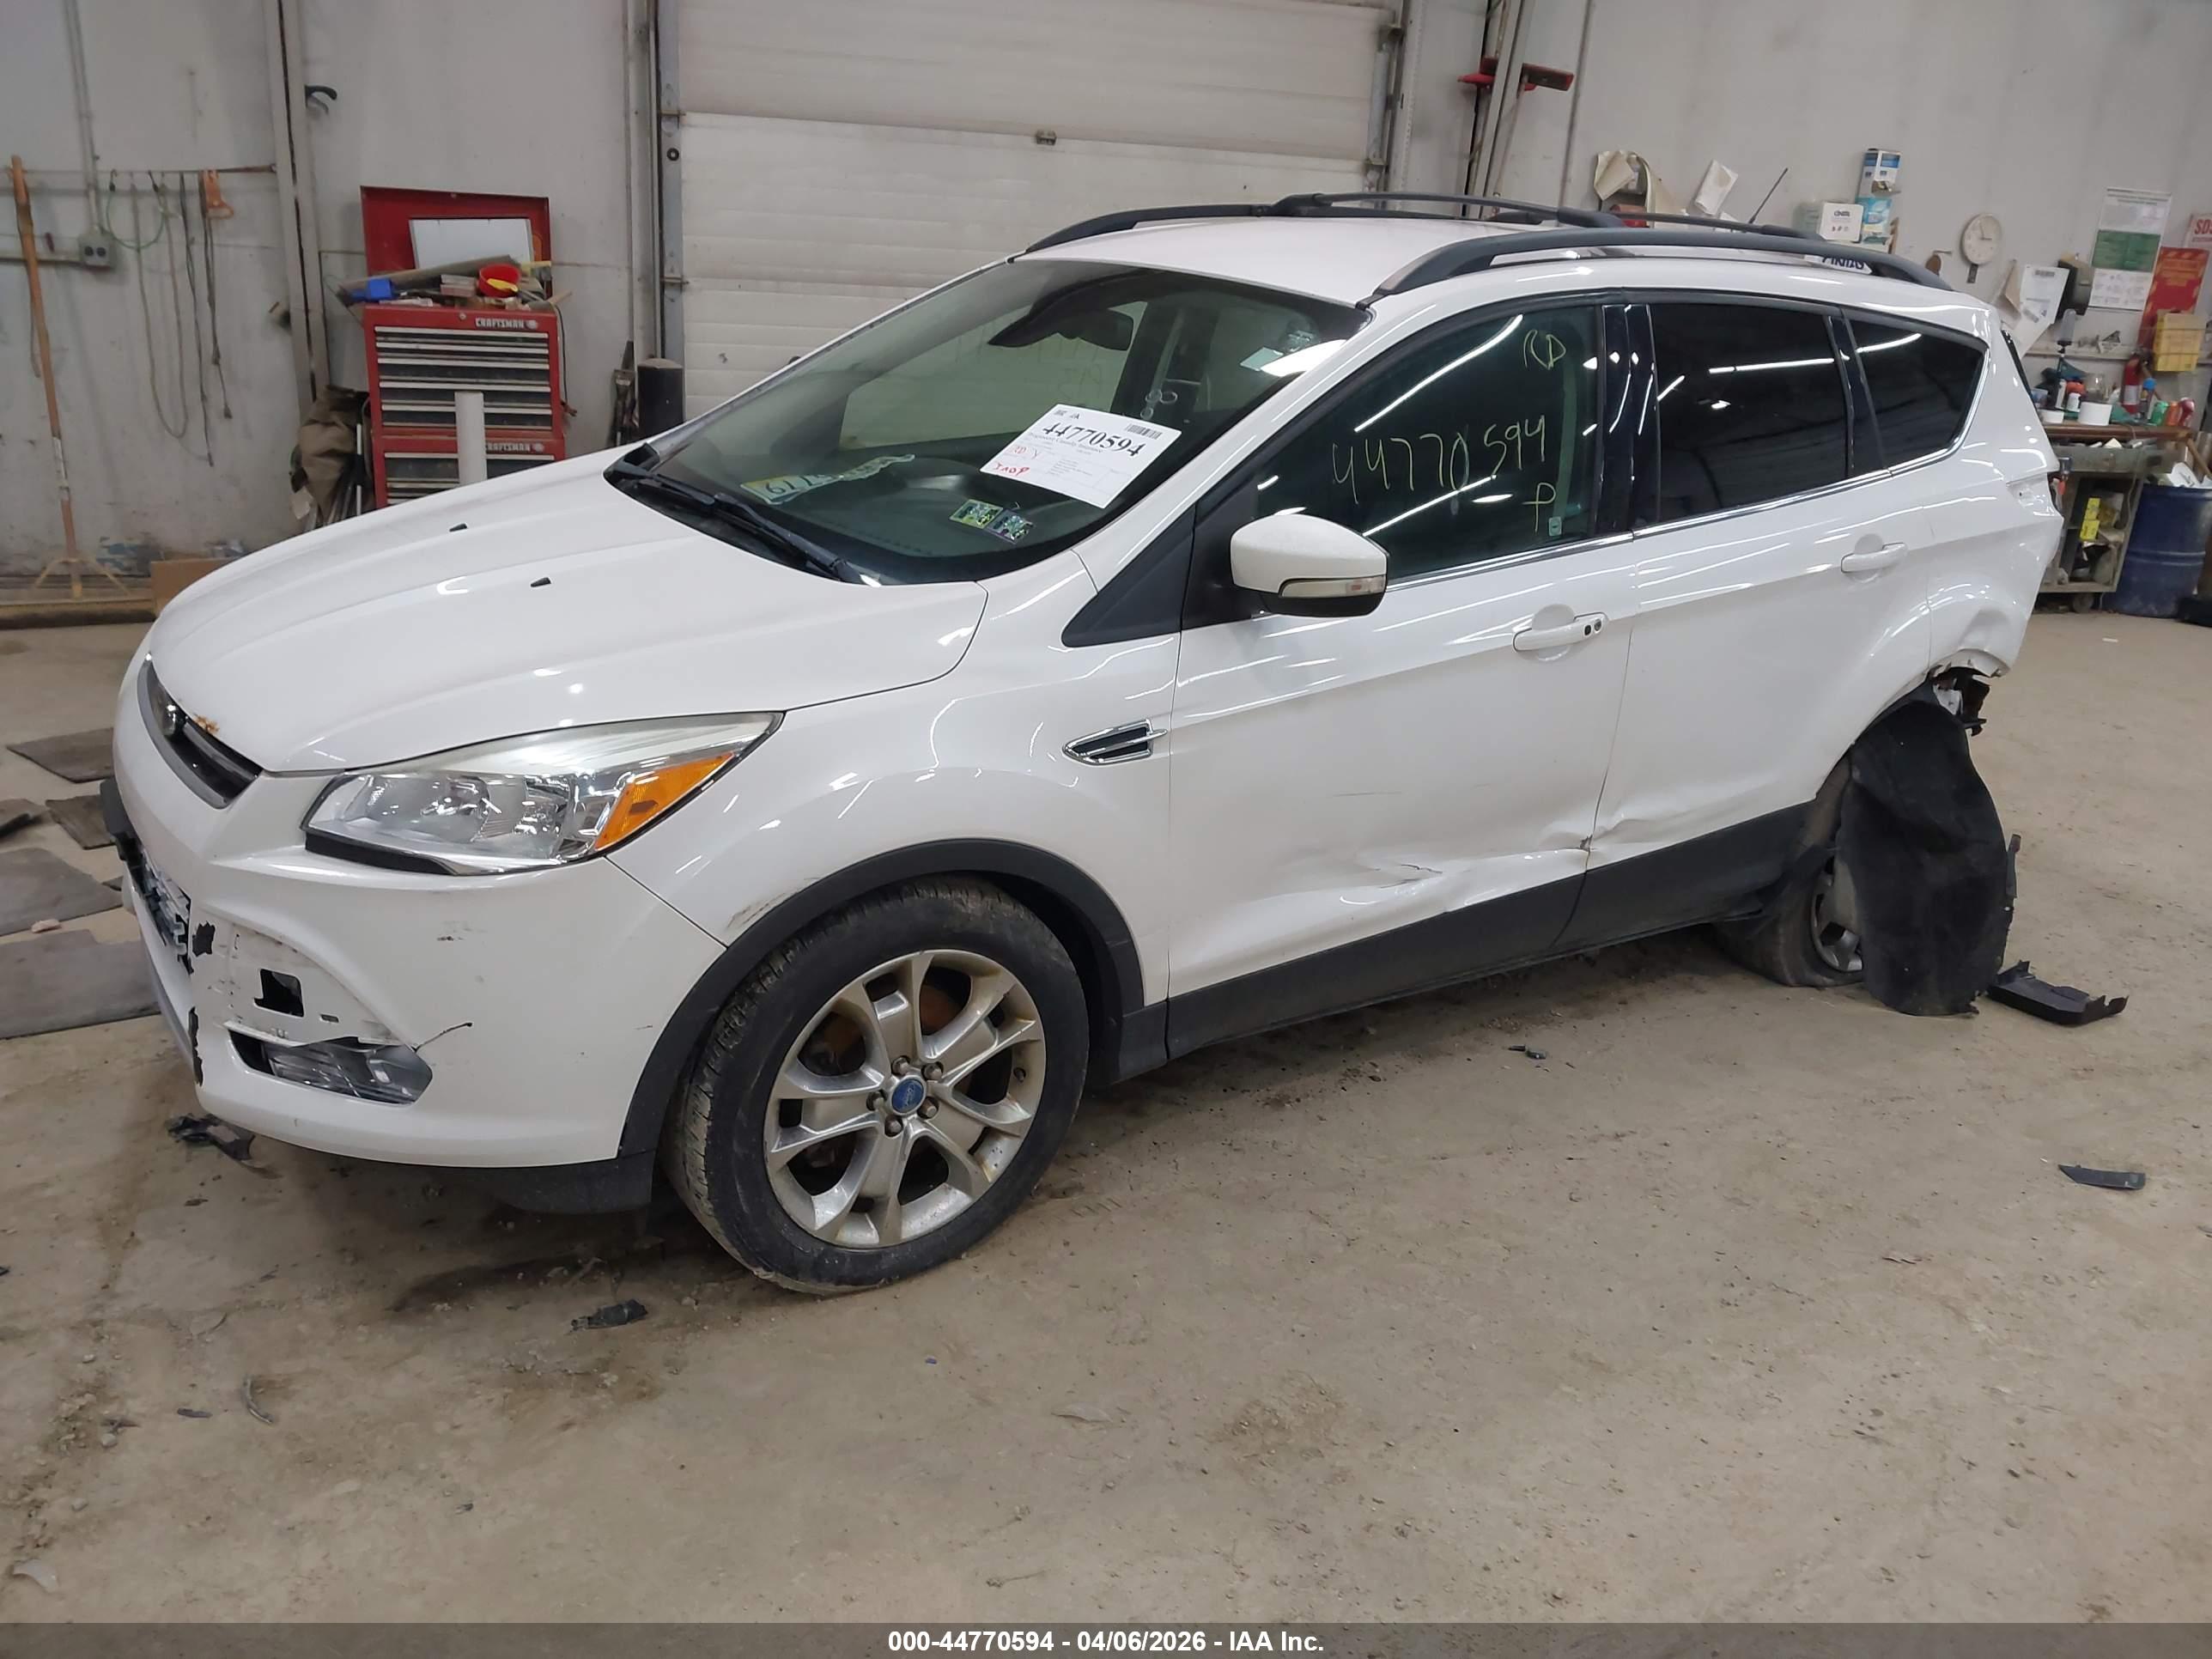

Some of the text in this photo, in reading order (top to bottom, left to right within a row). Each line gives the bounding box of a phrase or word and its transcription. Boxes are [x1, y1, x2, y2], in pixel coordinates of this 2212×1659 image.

[475, 317, 524, 329] CRAFTSMAN
[1042, 422, 1147, 457] 44770594
[1332, 415, 1546, 505] 44770594
